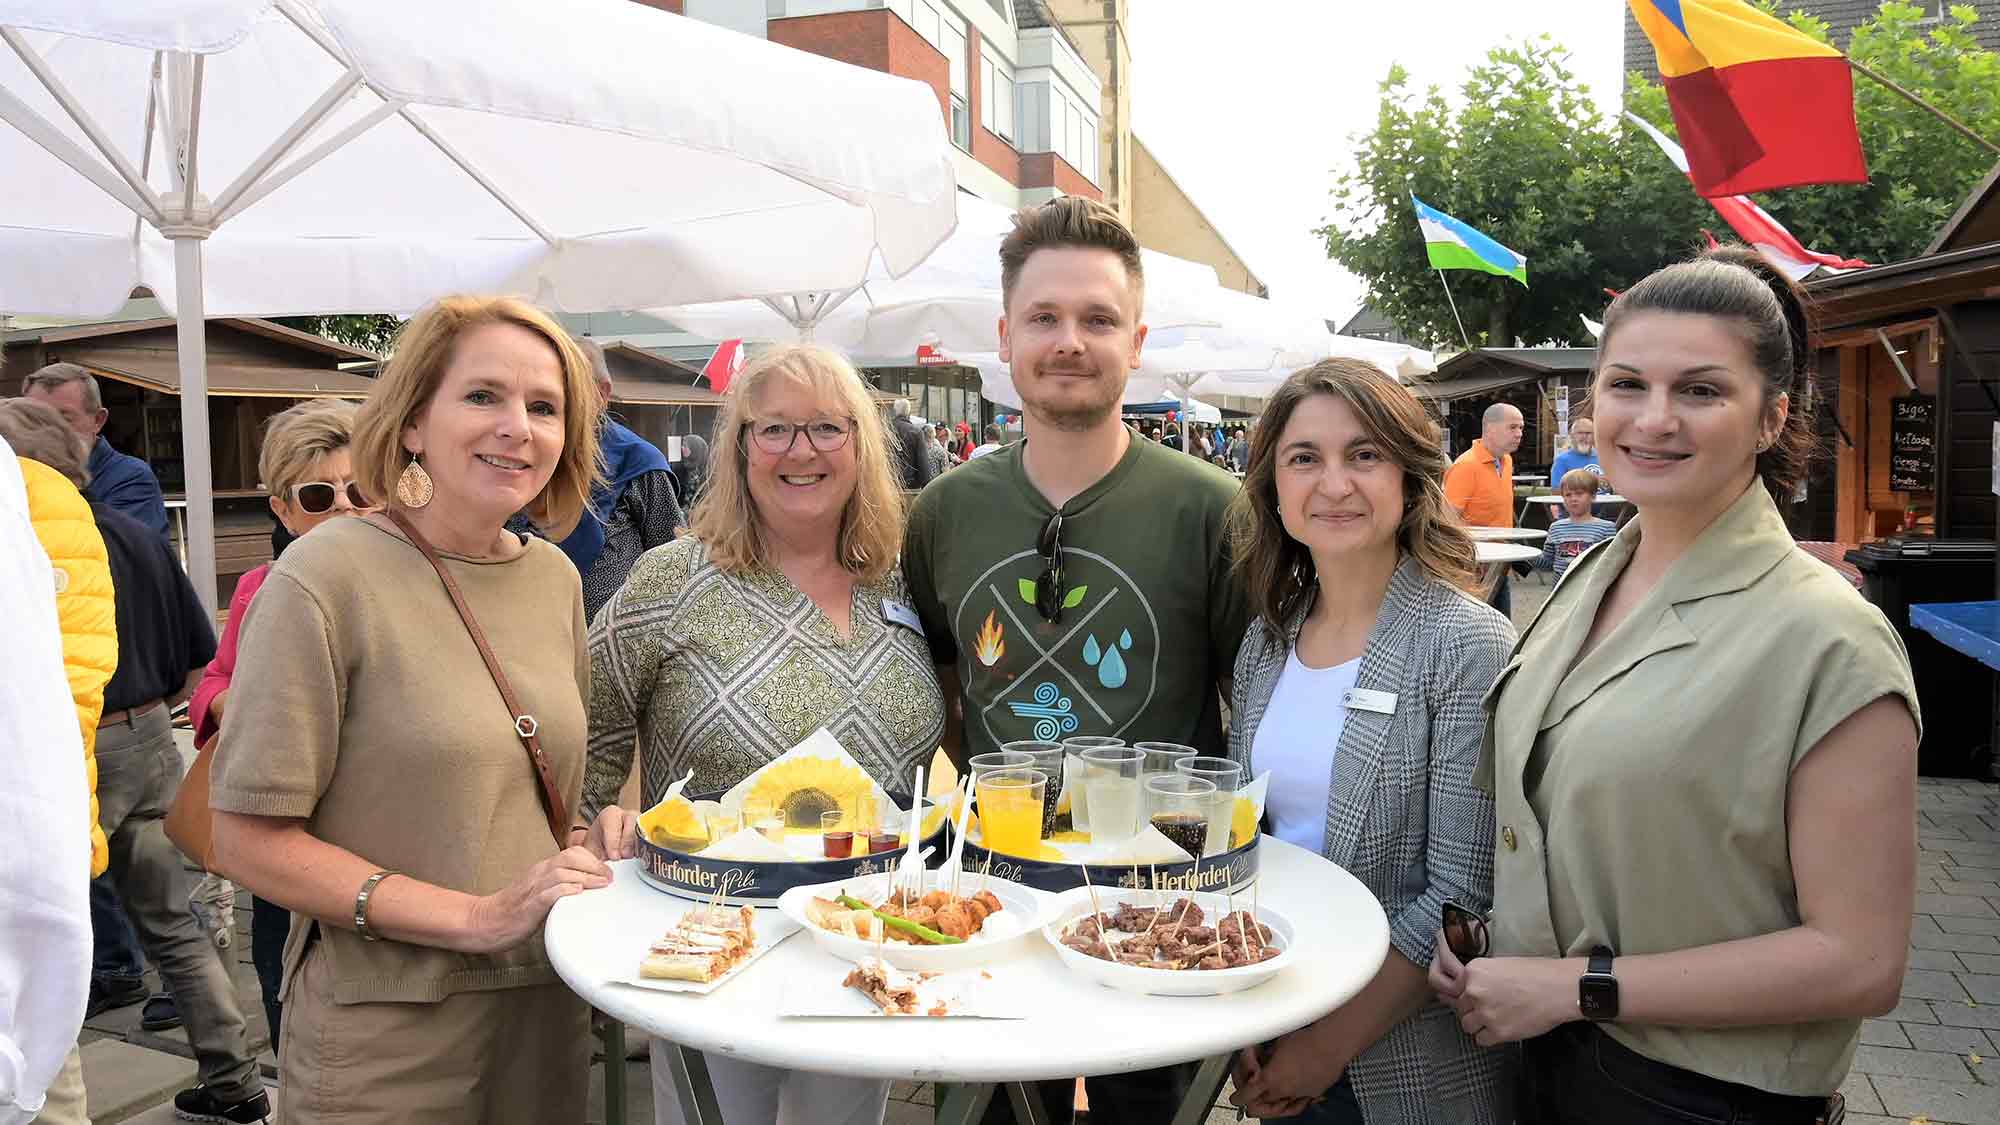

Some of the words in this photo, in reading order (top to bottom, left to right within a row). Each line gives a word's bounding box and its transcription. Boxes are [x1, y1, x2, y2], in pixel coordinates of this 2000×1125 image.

[653, 853, 718, 888] Herforder
[722, 867, 757, 891] Pils
[994, 861, 1022, 881] Pils
[1153, 864, 1228, 891] Herforder
